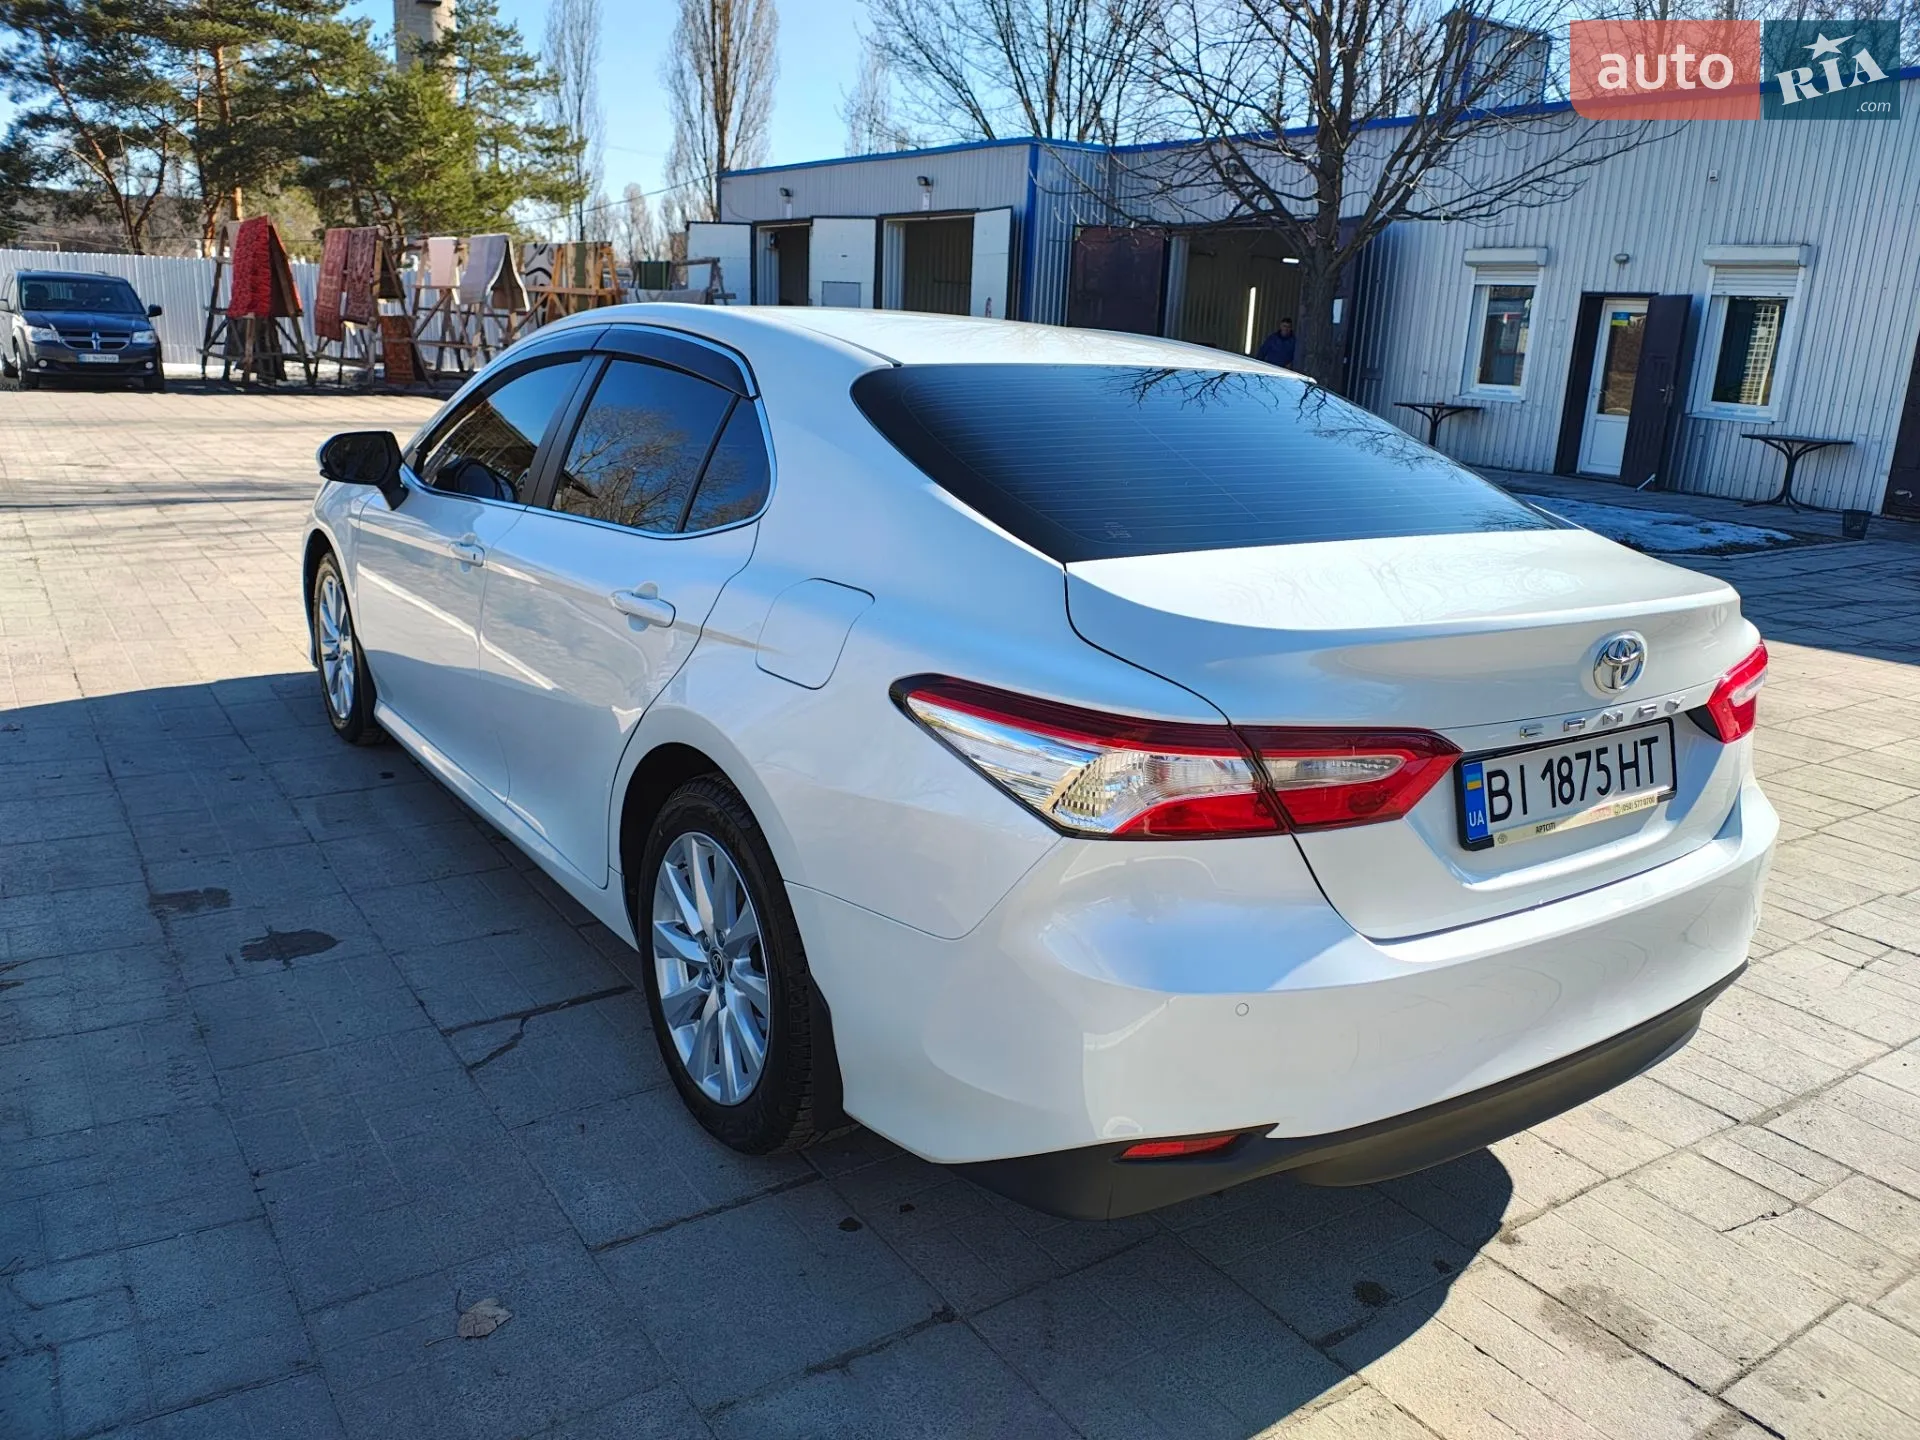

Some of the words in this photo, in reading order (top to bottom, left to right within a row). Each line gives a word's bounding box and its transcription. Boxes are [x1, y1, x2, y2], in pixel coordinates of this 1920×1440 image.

[1519, 696, 1686, 739] CAMRY
[1486, 764, 1528, 823] BI
[1541, 746, 1612, 808] 1875
[1618, 735, 1659, 791] HT
[1468, 809, 1485, 827] UA
